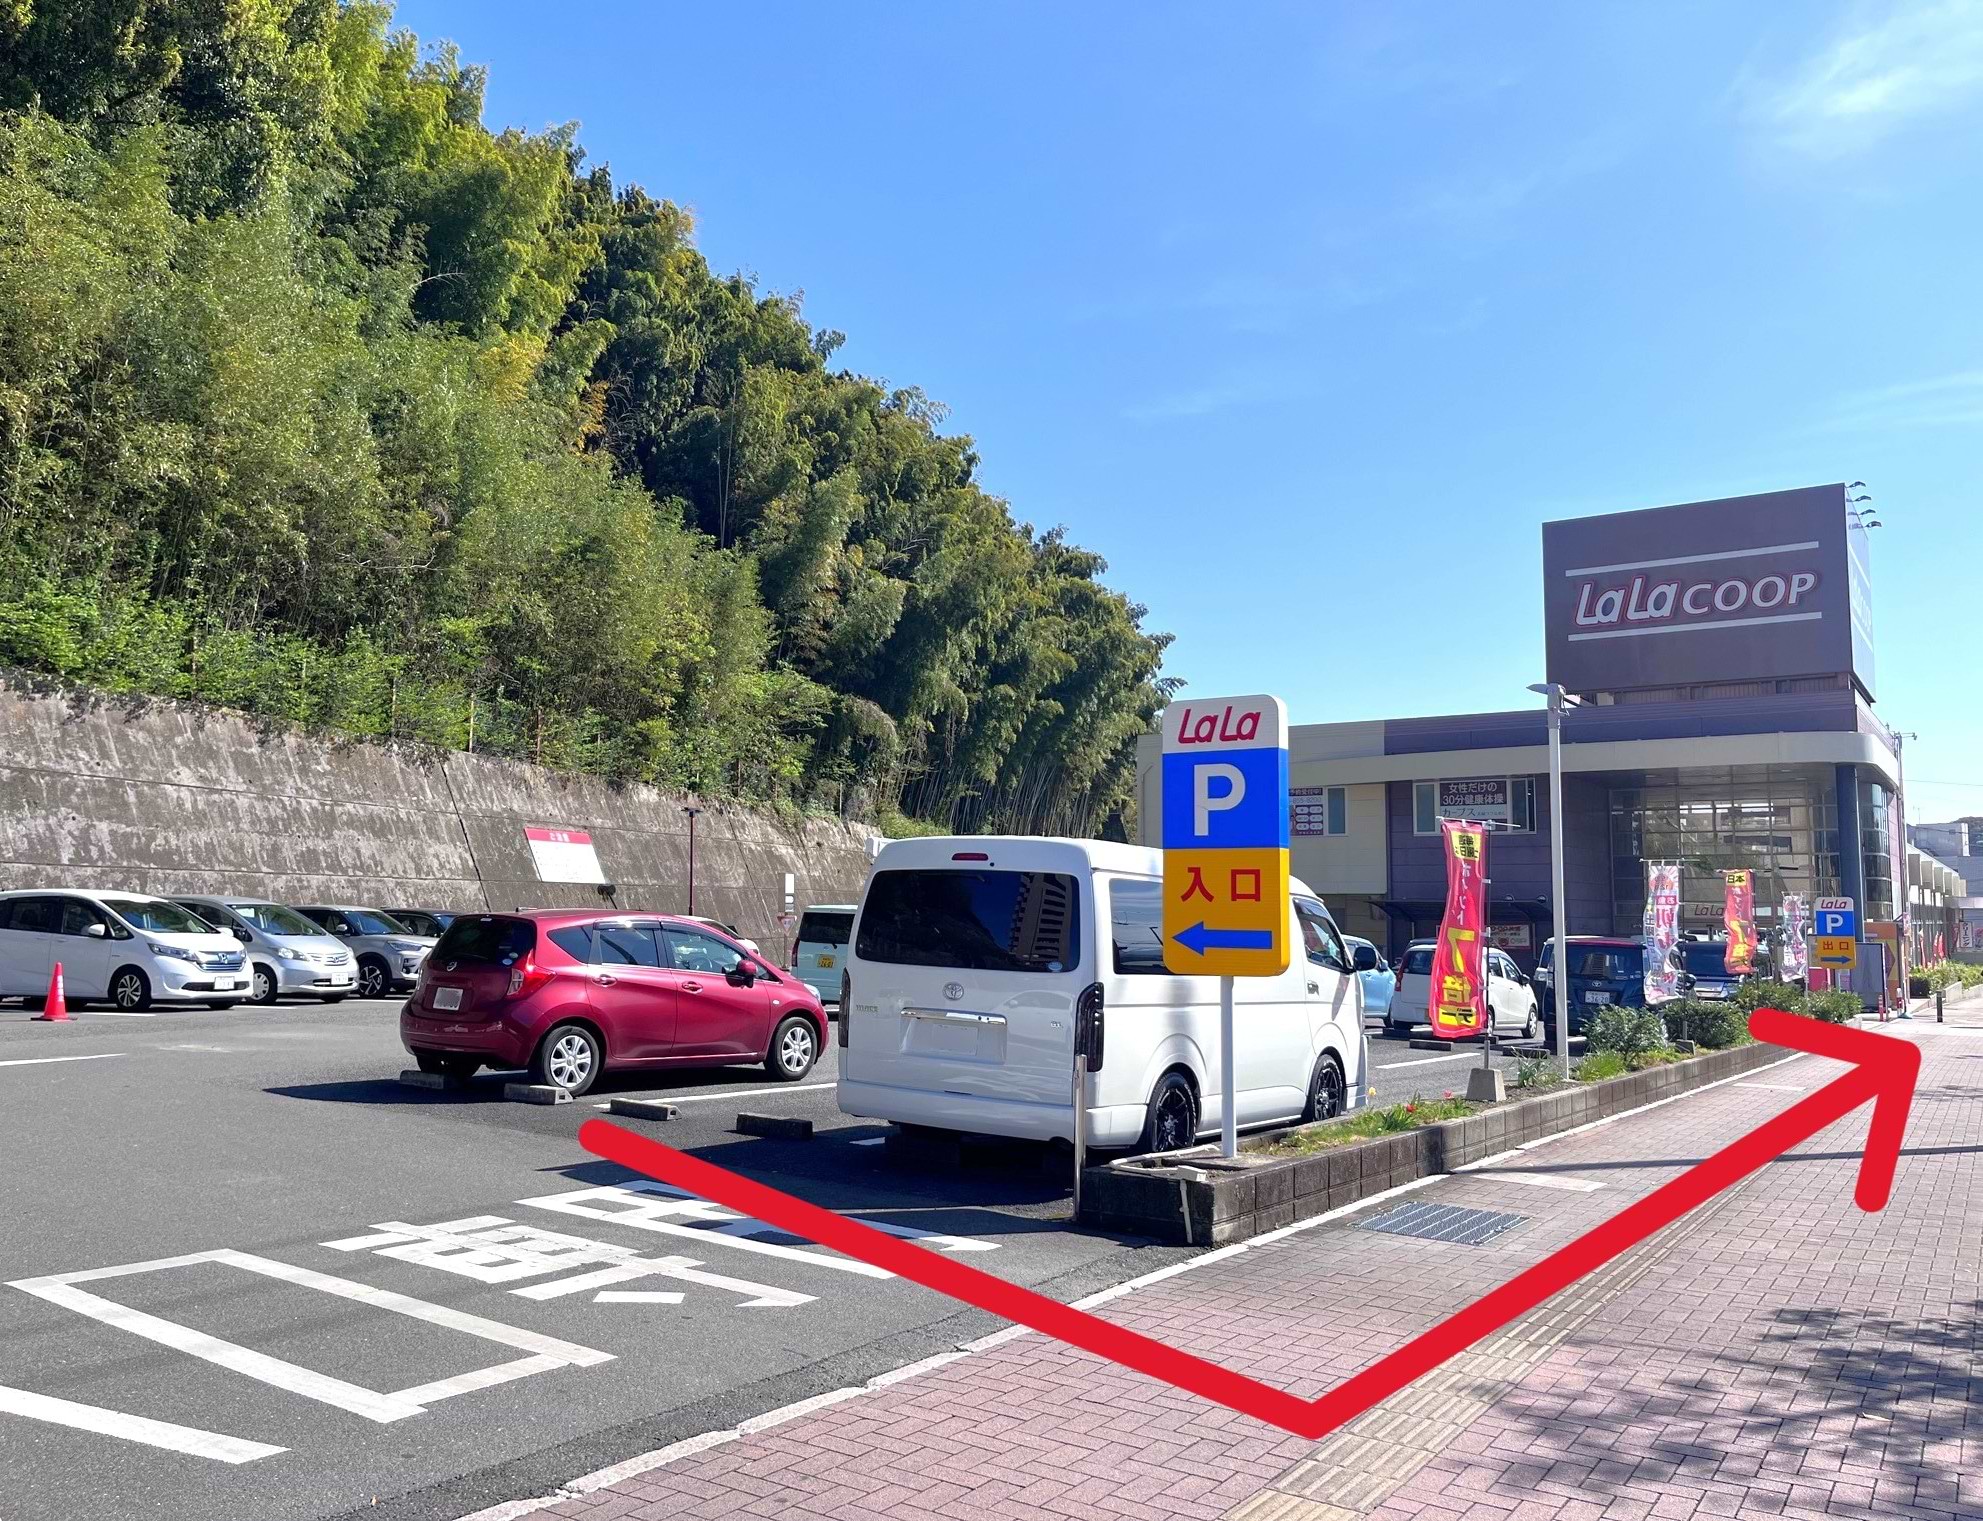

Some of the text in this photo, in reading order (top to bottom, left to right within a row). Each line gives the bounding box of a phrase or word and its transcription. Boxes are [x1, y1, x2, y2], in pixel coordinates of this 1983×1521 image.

[1178, 705, 1261, 744] LaLa
[1448, 782, 1498, 794] 女性だけの
[1193, 763, 1246, 836] P
[1443, 793, 1504, 805] 30分健康体操
[1180, 866, 1261, 903] 入口
[1820, 899, 1847, 909] LaLa
[1826, 914, 1843, 934] P
[1823, 940, 1849, 951] 出口
